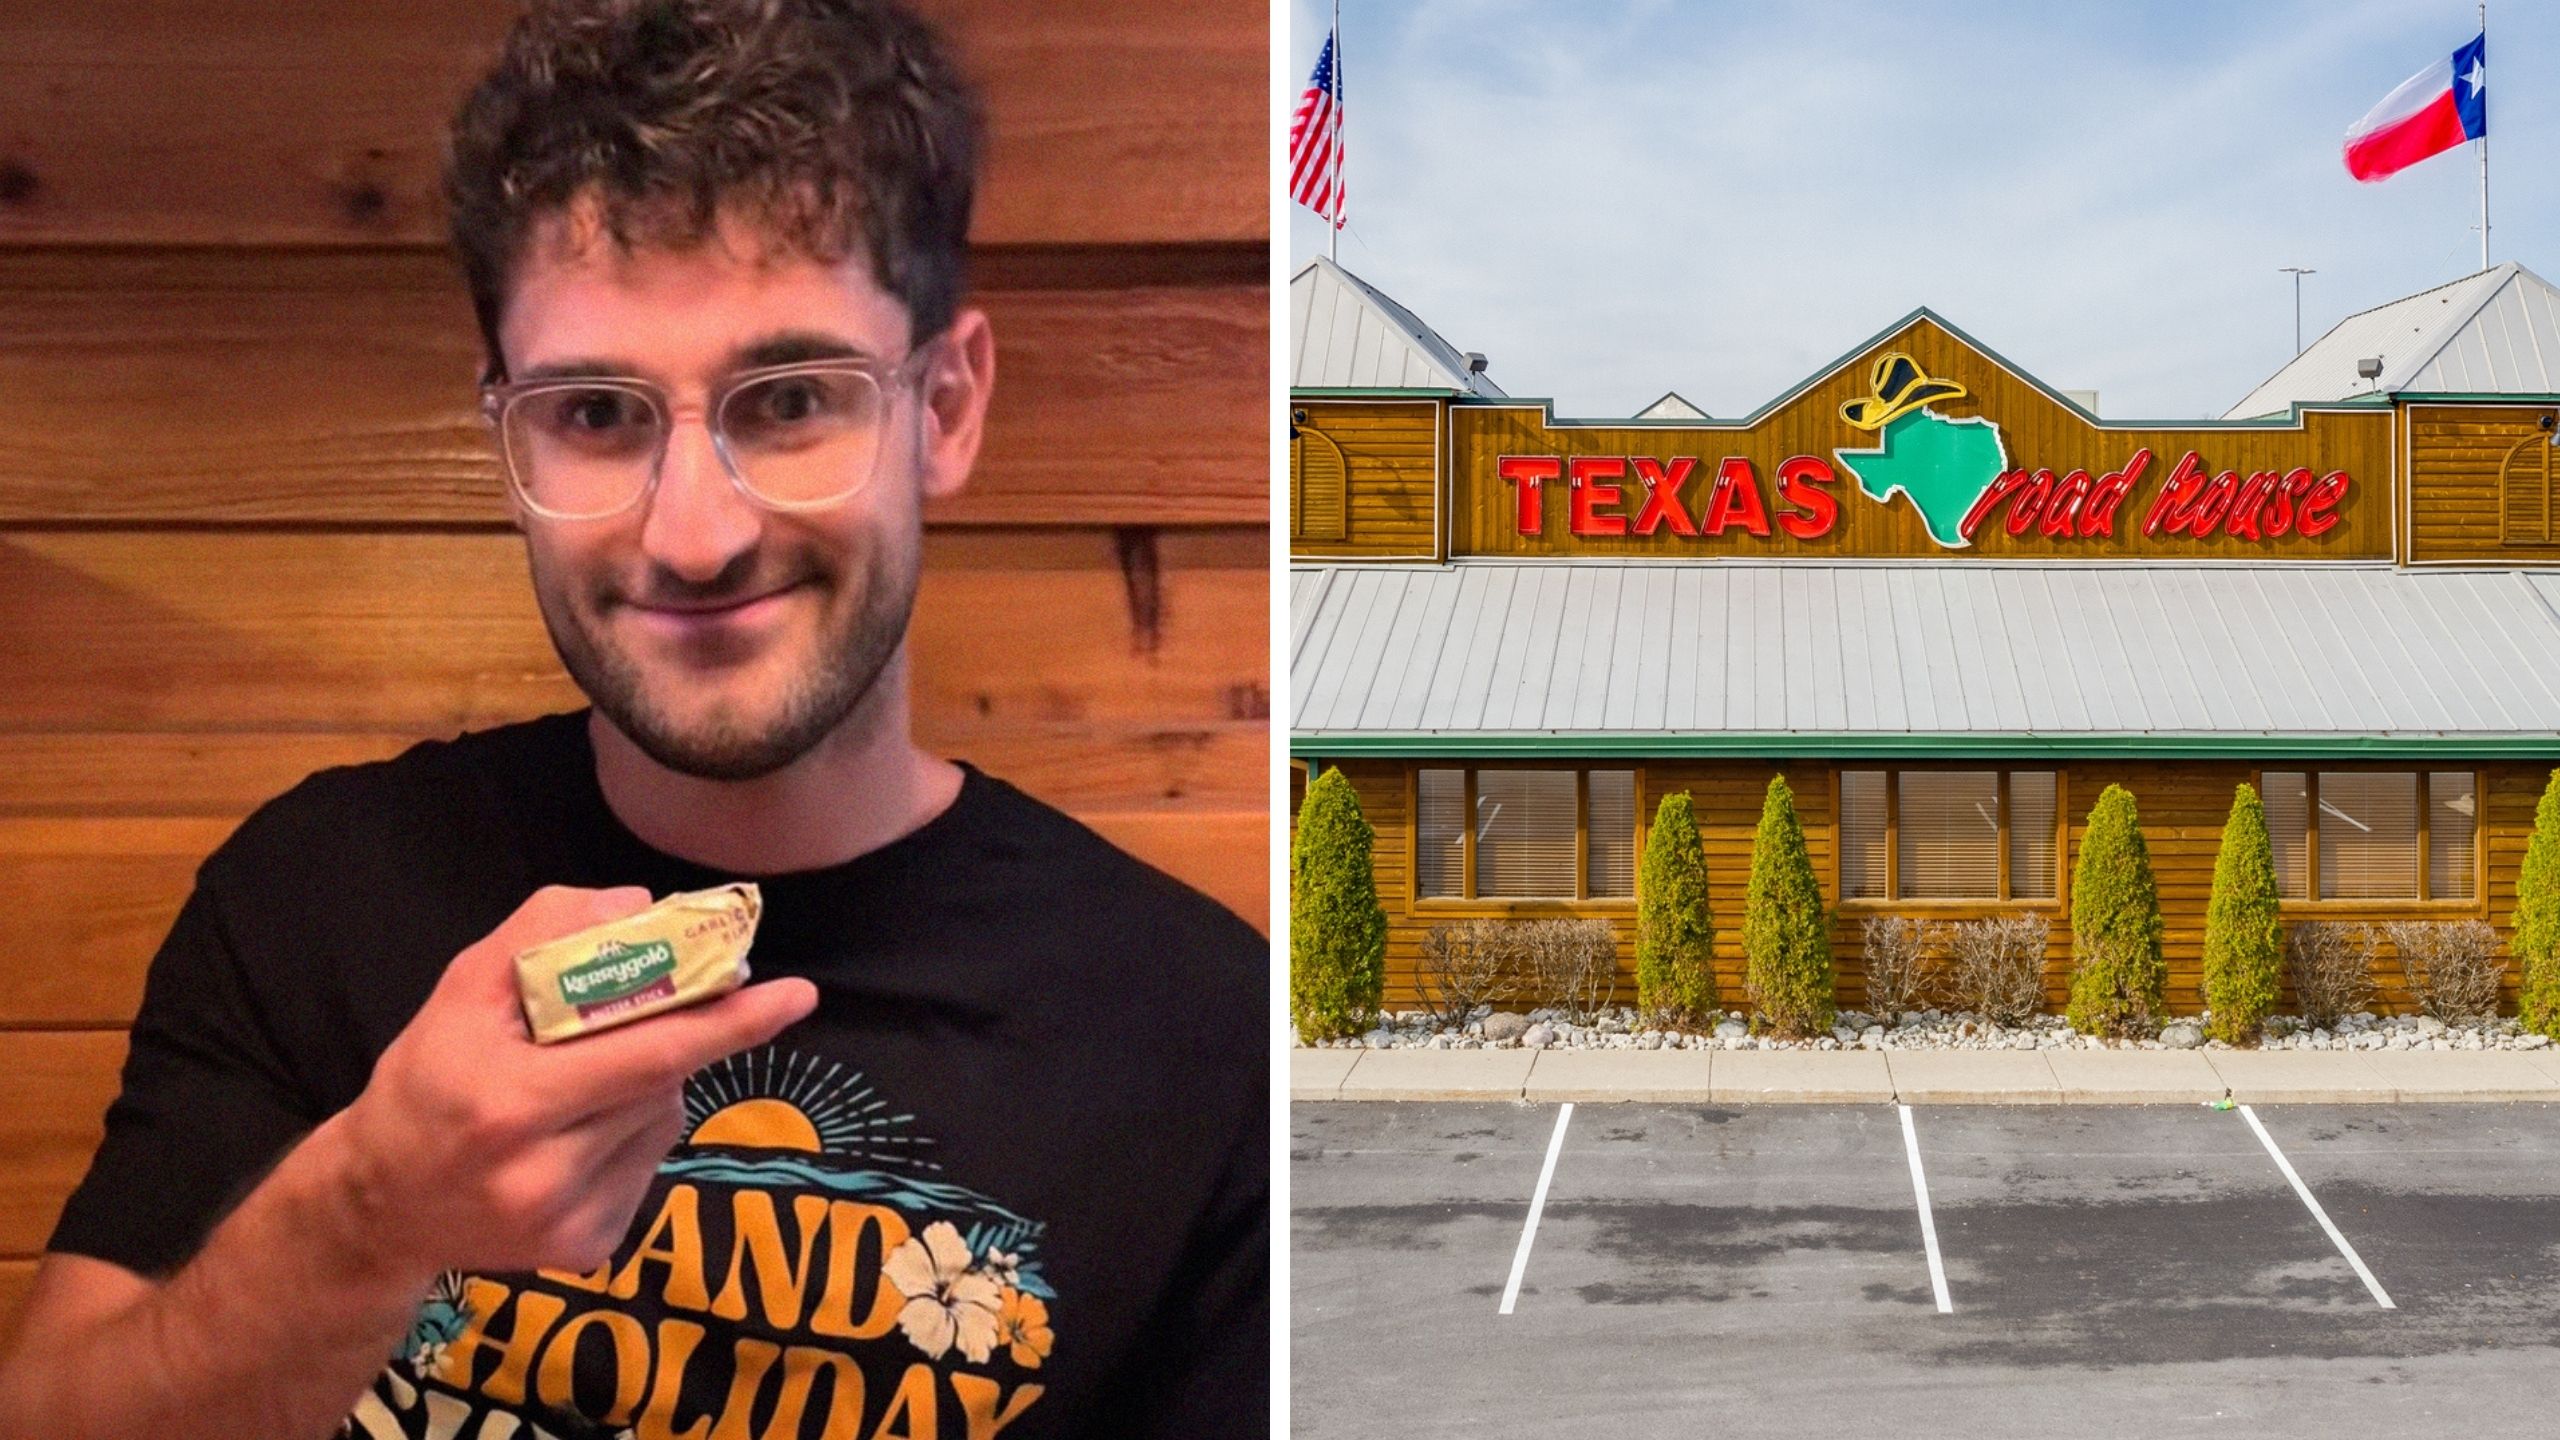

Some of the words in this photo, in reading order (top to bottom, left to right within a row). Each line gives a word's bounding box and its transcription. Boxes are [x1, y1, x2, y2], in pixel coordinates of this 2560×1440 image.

[1497, 454, 1838, 539] TEXAS
[1960, 447, 2152, 538] road
[2141, 450, 2349, 541] house
